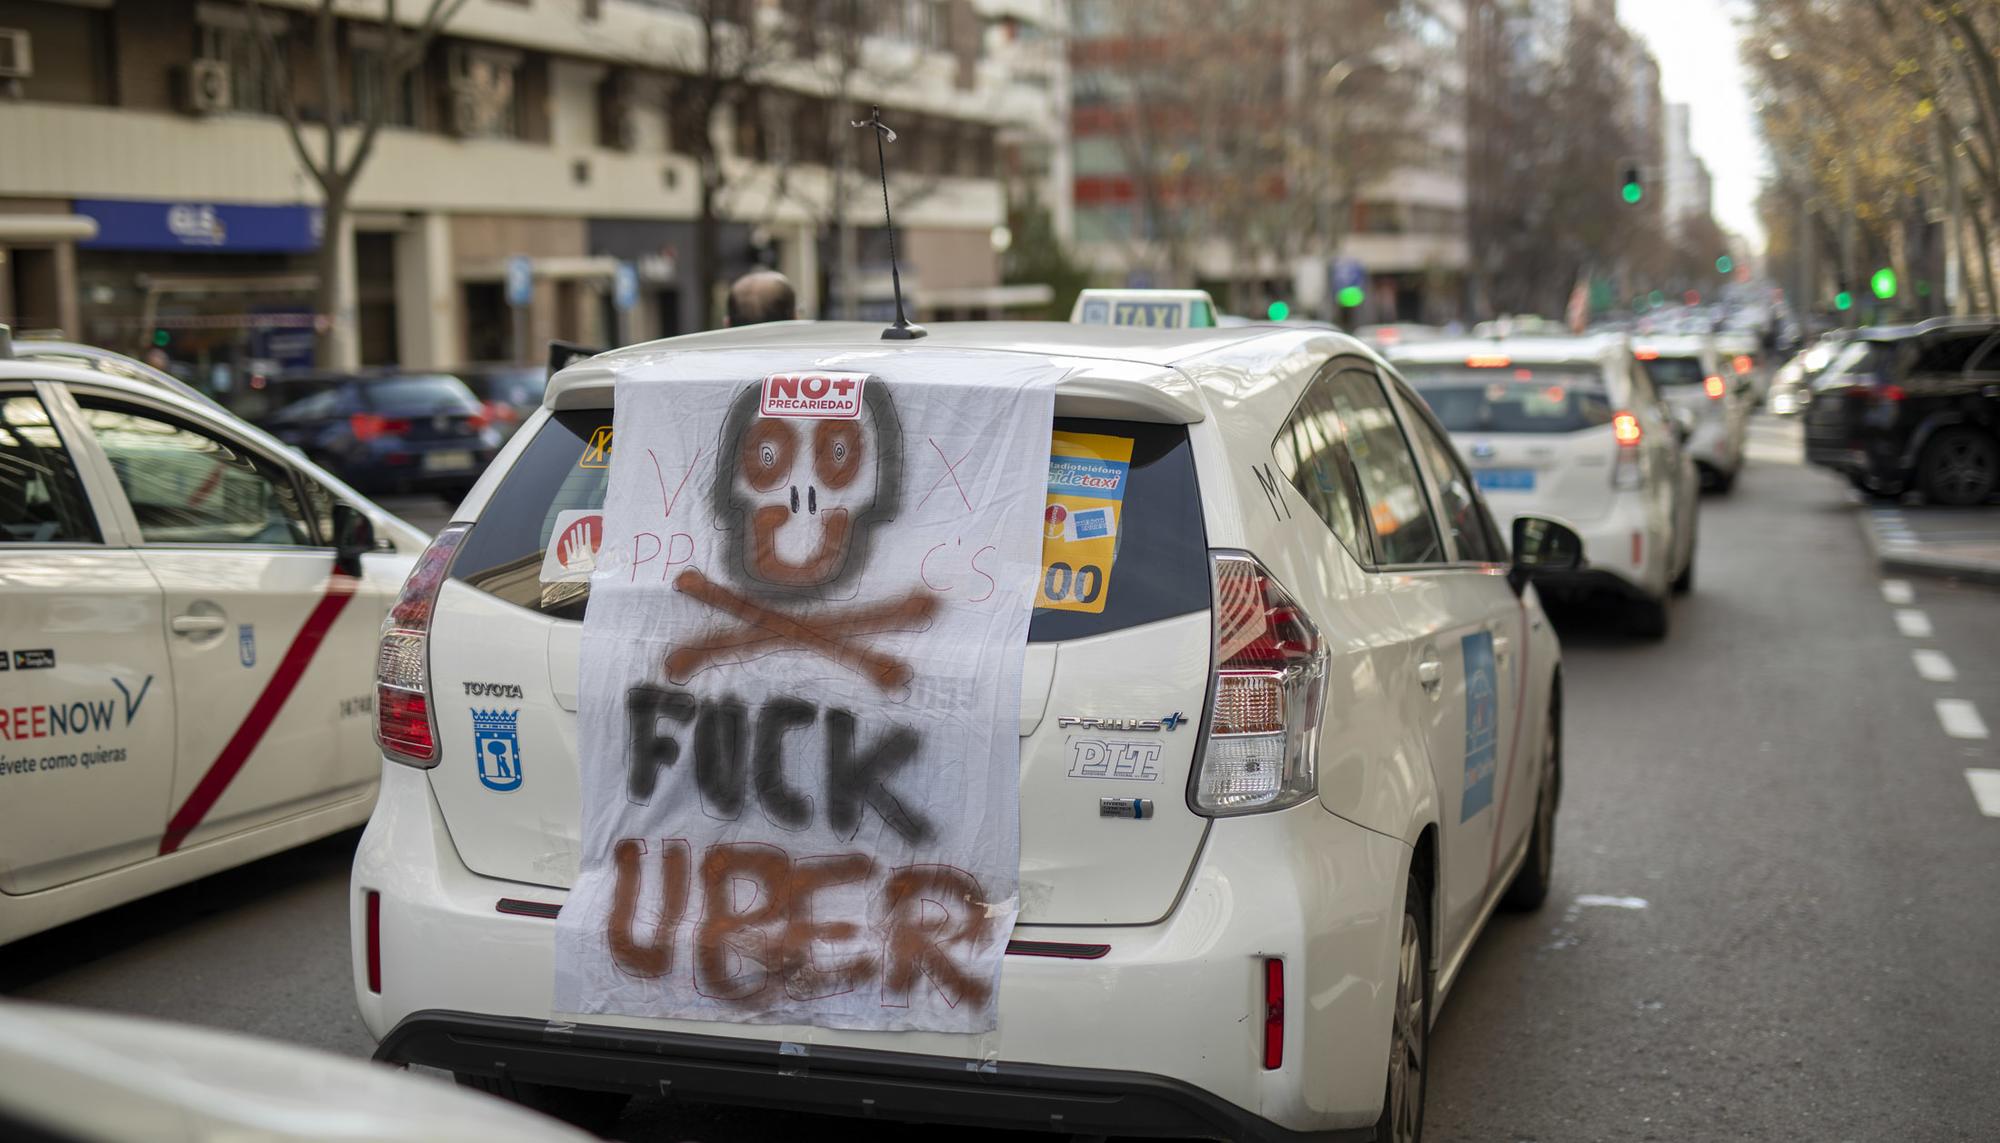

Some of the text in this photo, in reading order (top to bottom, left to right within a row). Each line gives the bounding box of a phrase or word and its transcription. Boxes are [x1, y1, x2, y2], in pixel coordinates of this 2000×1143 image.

[1118, 305, 1178, 328] TAXI
[769, 376, 855, 399] NO+
[768, 400, 853, 410] PRECARIEDAD
[648, 438, 974, 517] V X
[632, 532, 695, 582] PP
[462, 682, 523, 699] TOYOTA
[40, 753, 77, 771] como
[81, 745, 127, 769] quieras
[623, 681, 938, 844] FUCK
[607, 838, 994, 1010] UBER
